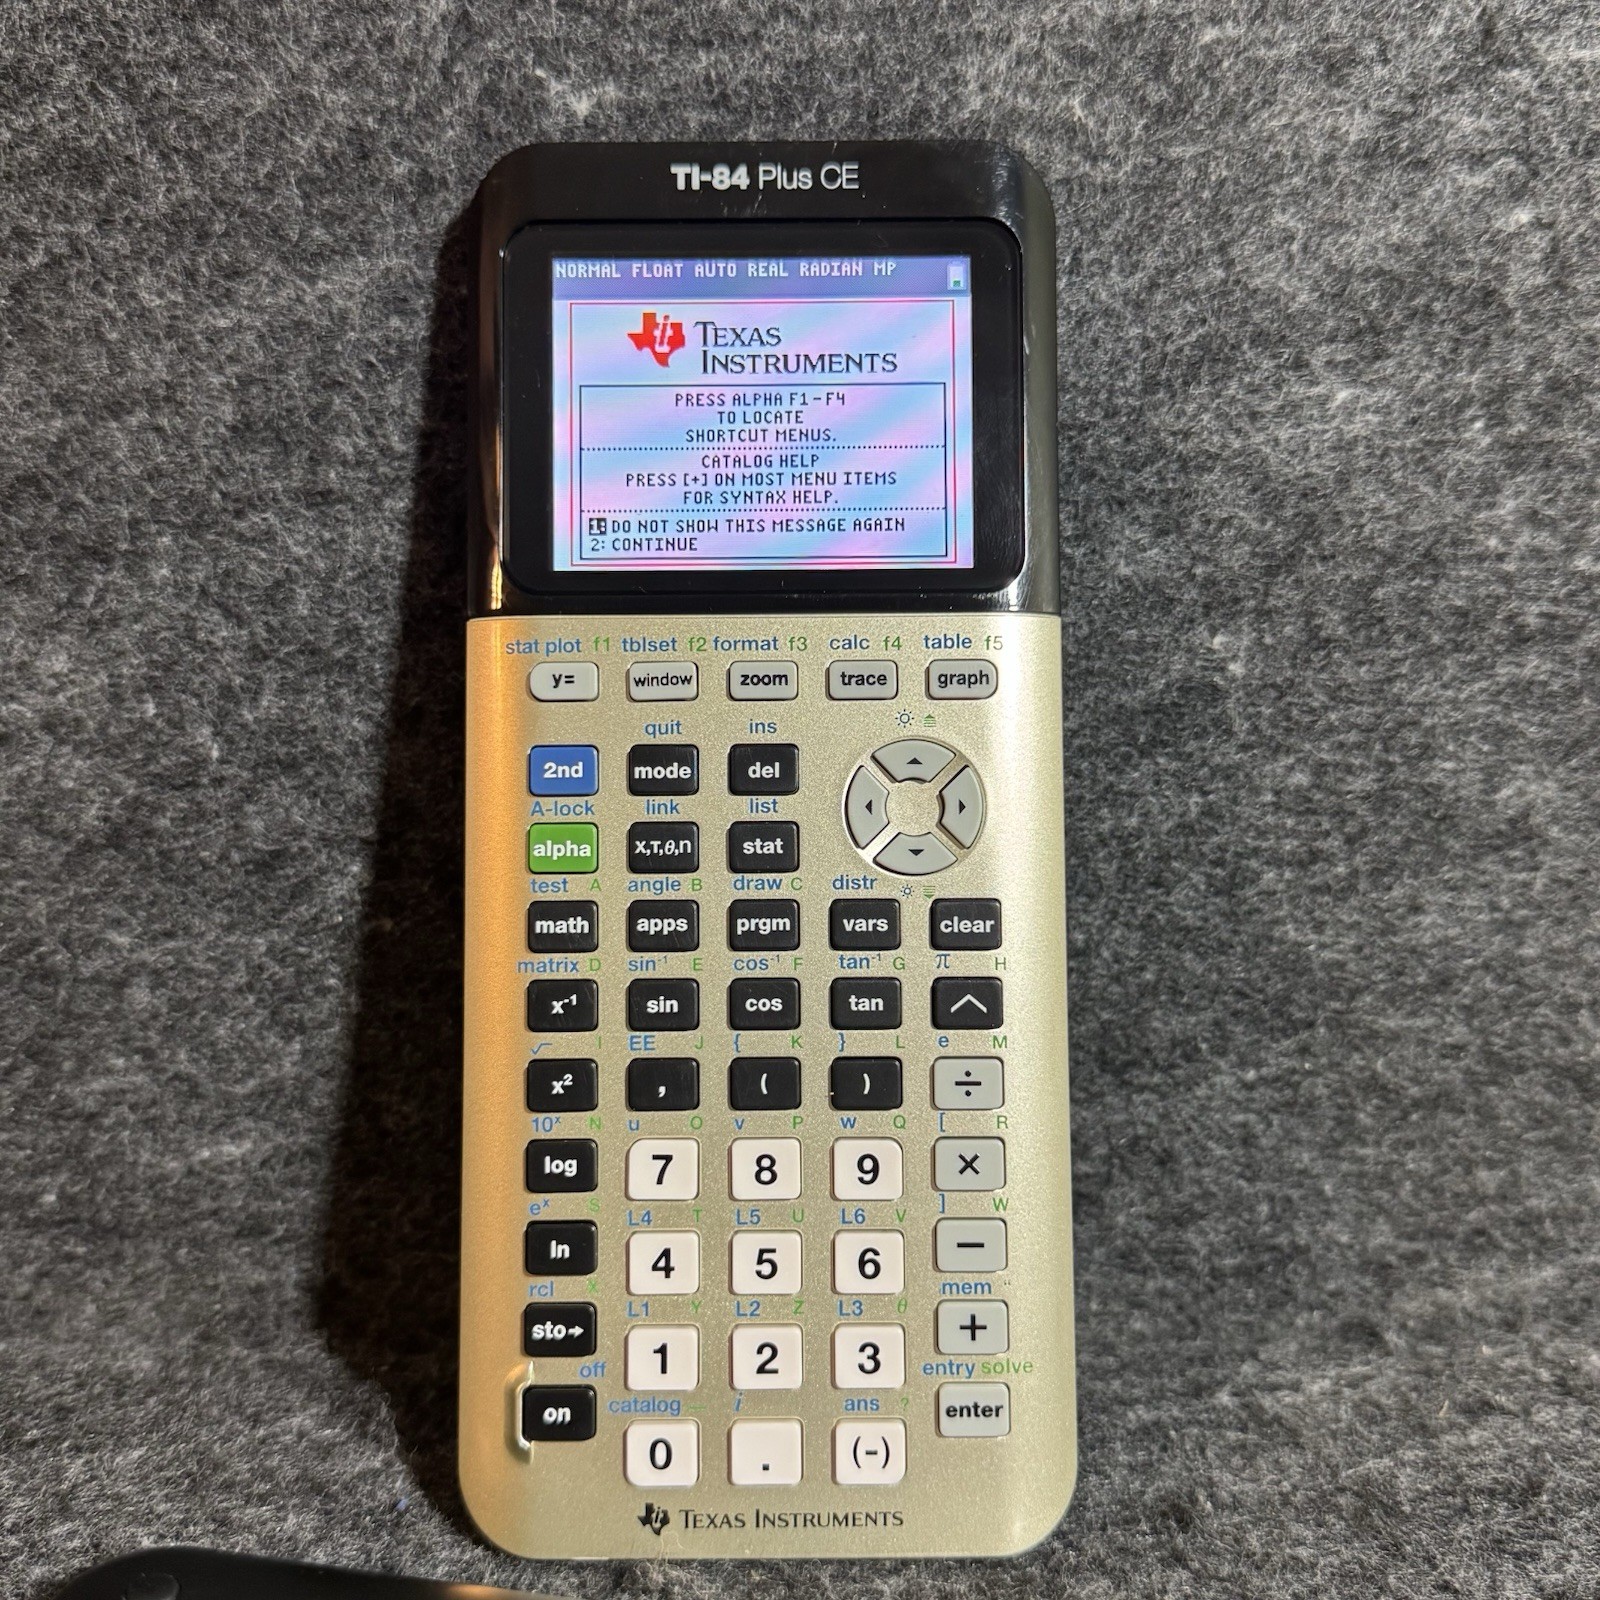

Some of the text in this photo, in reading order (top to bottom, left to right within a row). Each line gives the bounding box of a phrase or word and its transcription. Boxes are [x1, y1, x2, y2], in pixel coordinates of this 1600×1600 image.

[670, 161, 859, 190] TI-84 Plus CE
[556, 262, 896, 278] NORMAL FLOAT AUTO REAL RADIAN MP
[693, 322, 782, 347] TEXAS
[702, 350, 898, 374] INSTRUMENTS
[675, 393, 726, 407] PRESS
[732, 393, 782, 406] ALPHA
[718, 411, 804, 424] TO LOCATE
[686, 429, 836, 442] SHORTCUT MENUS.
[702, 454, 819, 468] CATALOG HELP
[626, 472, 897, 487] PRESS [+] ON MOST MENU ITEMS
[683, 490, 838, 505] FOR SYNTAX HELP.
[612, 520, 631, 533] DO
[638, 520, 668, 533] NOT
[676, 520, 718, 532] SHOW
[726, 519, 765, 532] THIS
[772, 518, 846, 532] MESSAGE
[853, 518, 905, 532] AGAIN
[591, 538, 698, 551] 2: CONTINUE
[506, 638, 581, 656] stat plot
[593, 637, 610, 651] f1
[622, 637, 677, 652] tblset
[688, 637, 707, 651] f2
[713, 636, 779, 651] format
[789, 637, 808, 651] f3
[829, 634, 870, 650] calc
[883, 636, 902, 650] f4
[923, 634, 972, 650] table
[985, 635, 1003, 650] f5
[552, 673, 575, 688] y=
[633, 673, 692, 687] window
[740, 674, 788, 686] zoom
[841, 671, 888, 686] trace
[938, 670, 990, 688] graph
[644, 720, 682, 738] quit
[749, 719, 777, 734] ins
[543, 762, 583, 778] 2nd
[634, 763, 692, 779] mode
[748, 762, 780, 778] del
[530, 800, 595, 816] A-lock
[645, 799, 680, 815] link
[749, 798, 778, 813] list
[533, 841, 592, 860] alpha
[743, 838, 783, 854] stat
[530, 879, 568, 893] test
[590, 879, 601, 891] A
[628, 877, 681, 895] angle
[691, 879, 702, 891] B
[733, 875, 783, 891] draw
[791, 877, 803, 890] C
[832, 875, 877, 890] distr
[535, 916, 589, 933] math
[636, 918, 688, 935] apps
[737, 917, 791, 935] prgm
[843, 918, 888, 932] vars
[940, 916, 995, 933] clear
[517, 958, 579, 973] matrix
[589, 959, 601, 971] D
[692, 958, 703, 971] E
[794, 958, 803, 970] F
[893, 957, 905, 970] G
[995, 957, 1006, 970] H
[647, 996, 678, 1013] sin
[745, 998, 783, 1012] cos
[849, 995, 884, 1011] tan
[629, 1035, 655, 1051] EE
[694, 1036, 703, 1050] J
[791, 1035, 803, 1049] K
[896, 1035, 905, 1048] L
[938, 1036, 949, 1048] e
[993, 1035, 1007, 1048] M
[590, 1117, 601, 1130] N
[628, 1119, 640, 1131] u
[734, 1119, 745, 1130] v
[792, 1116, 803, 1129] P
[840, 1117, 856, 1129] w
[893, 1115, 906, 1129] Q
[997, 1116, 1008, 1128] R
[544, 1156, 577, 1177] log
[651, 1154, 673, 1185] 7
[755, 1154, 777, 1185] 8
[857, 1154, 880, 1185] 9
[589, 1198, 600, 1212] S
[993, 1198, 1009, 1211] W
[627, 1210, 652, 1225] L4
[692, 1210, 702, 1223] T
[736, 1210, 761, 1225] L5
[792, 1210, 804, 1223] U
[841, 1209, 866, 1225] L6
[895, 1209, 907, 1222] V
[550, 1241, 570, 1259] ln
[651, 1247, 675, 1279] 4
[755, 1248, 777, 1279] 5
[858, 1247, 881, 1279] 6
[529, 1281, 554, 1297] rcl
[587, 1279, 599, 1292] X
[940, 1282, 992, 1295] mem
[627, 1301, 649, 1317] L1
[691, 1301, 703, 1314] Y
[735, 1301, 761, 1317] L2
[792, 1300, 804, 1315] Z
[838, 1301, 863, 1317] L3
[653, 1342, 668, 1375] 1
[756, 1342, 779, 1375] 2
[858, 1342, 881, 1374] 3
[579, 1361, 606, 1378] off
[922, 1359, 1033, 1379] entry solve
[608, 1397, 681, 1415] catalog
[844, 1398, 880, 1412] ans
[945, 1402, 1003, 1418] enter
[543, 1406, 571, 1424] on
[649, 1437, 672, 1470] 0
[679, 1508, 904, 1528] TEXAS INSTRUMENTS
